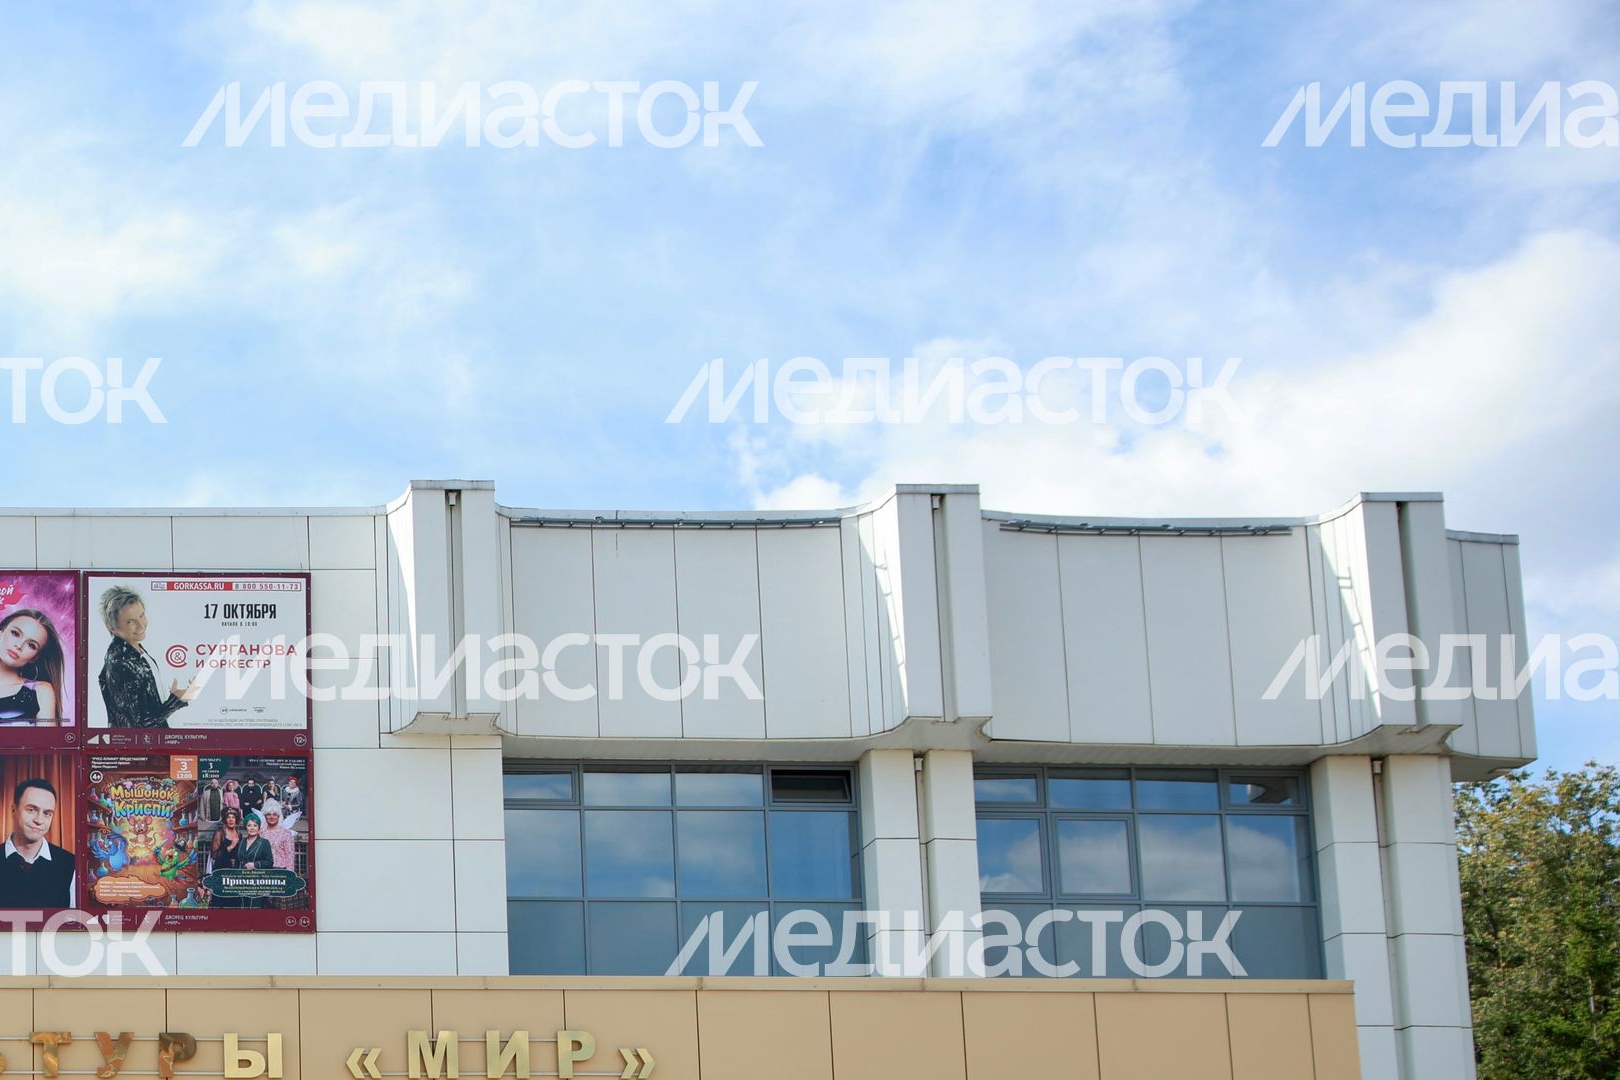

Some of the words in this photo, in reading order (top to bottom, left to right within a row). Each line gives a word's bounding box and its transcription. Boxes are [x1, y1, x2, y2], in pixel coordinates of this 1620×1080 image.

[174, 582, 224, 590] GORKASSA.RU
[204, 604, 218, 619] 17
[223, 604, 276, 619] ОКТЯБРЯ
[195, 644, 298, 656] СУРГАНОВА
[195, 659, 204, 668] И
[209, 659, 271, 669] ОРКЕСТР
[180, 761, 188, 771] 3
[110, 784, 175, 801] Мышонок
[115, 800, 172, 818] Криспи
[222, 877, 286, 887] Примадонны
[345, 1029, 656, 1080] «МИР»
